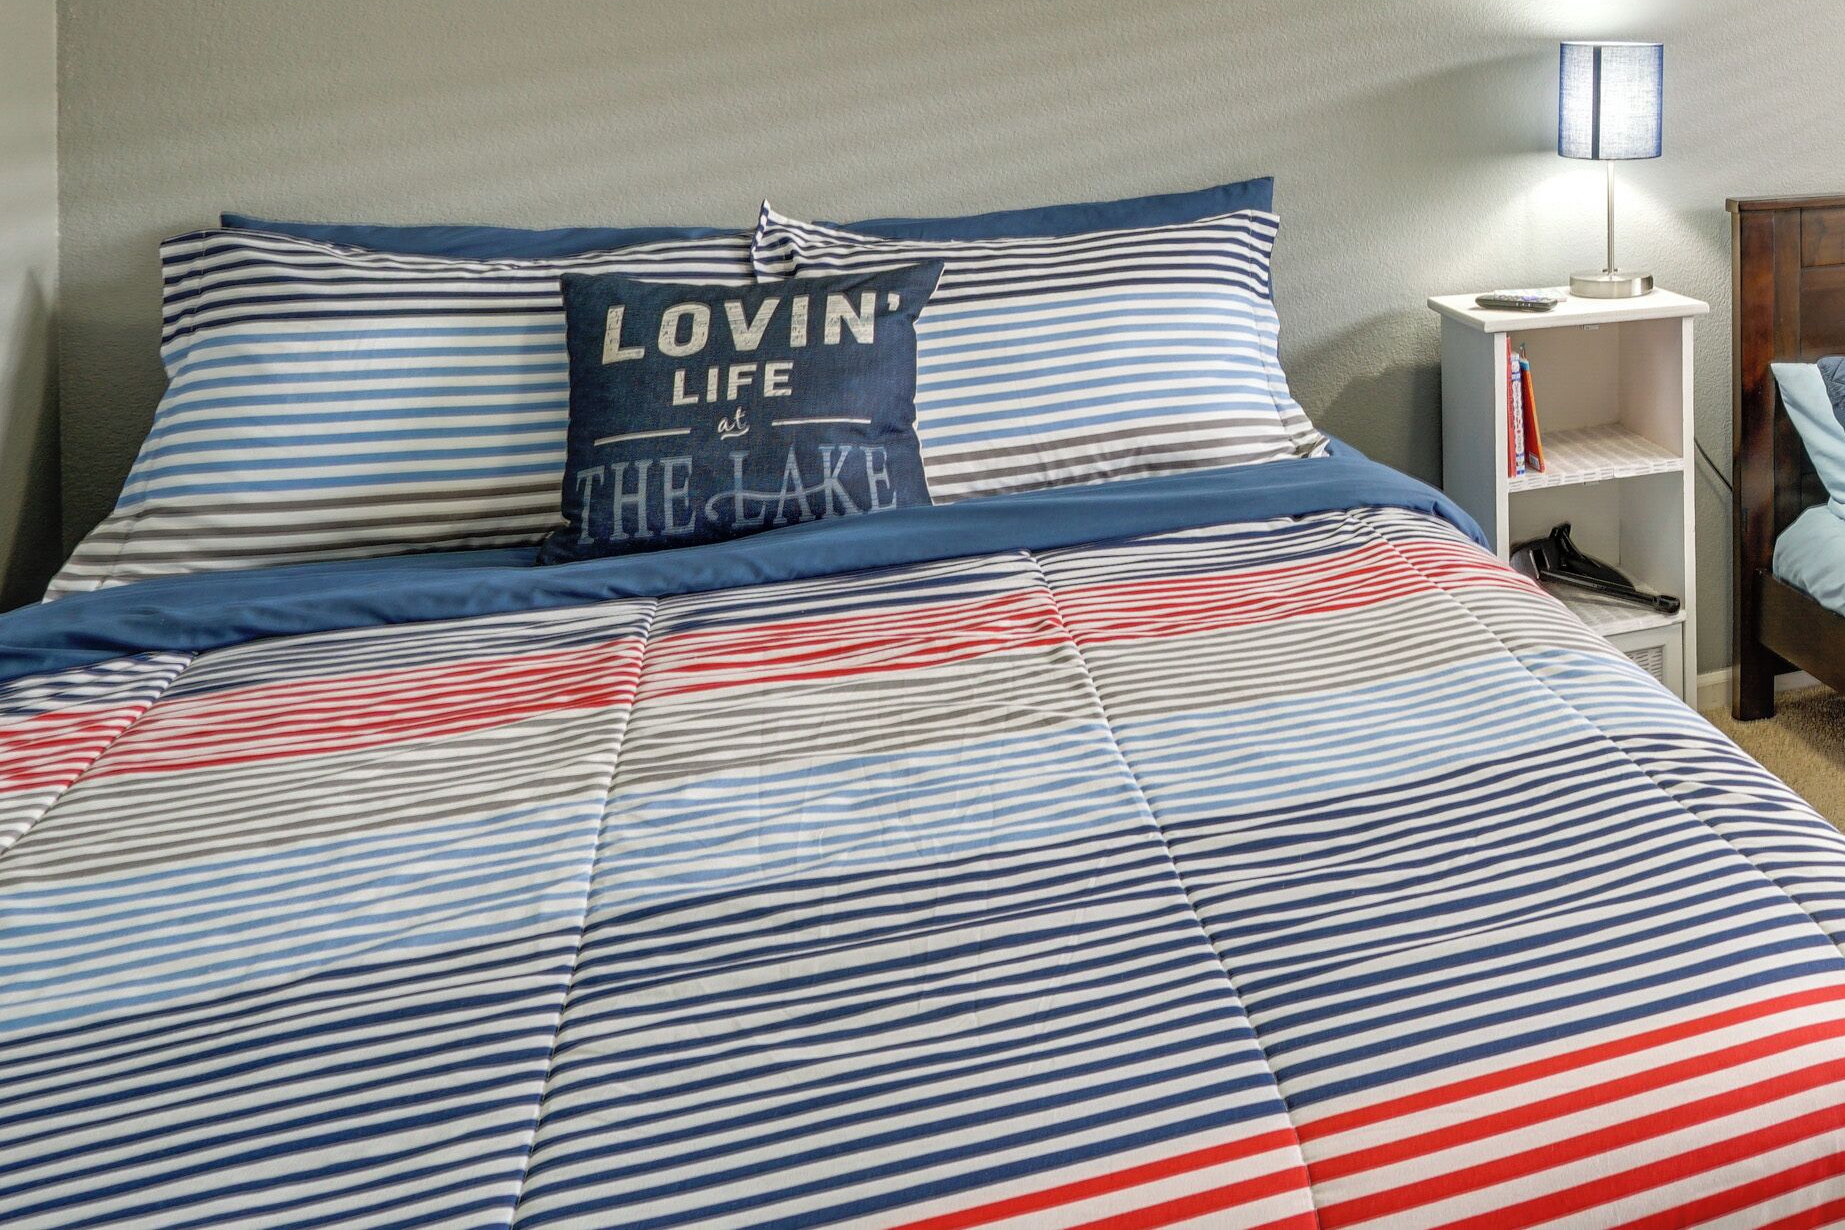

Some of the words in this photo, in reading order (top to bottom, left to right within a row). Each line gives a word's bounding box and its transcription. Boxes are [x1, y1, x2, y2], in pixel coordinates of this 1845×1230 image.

[601, 289, 901, 366] LOVIN'
[671, 359, 795, 407] LIFE
[716, 406, 751, 439] at
[575, 455, 698, 546] THE
[704, 443, 898, 529] LAKE
